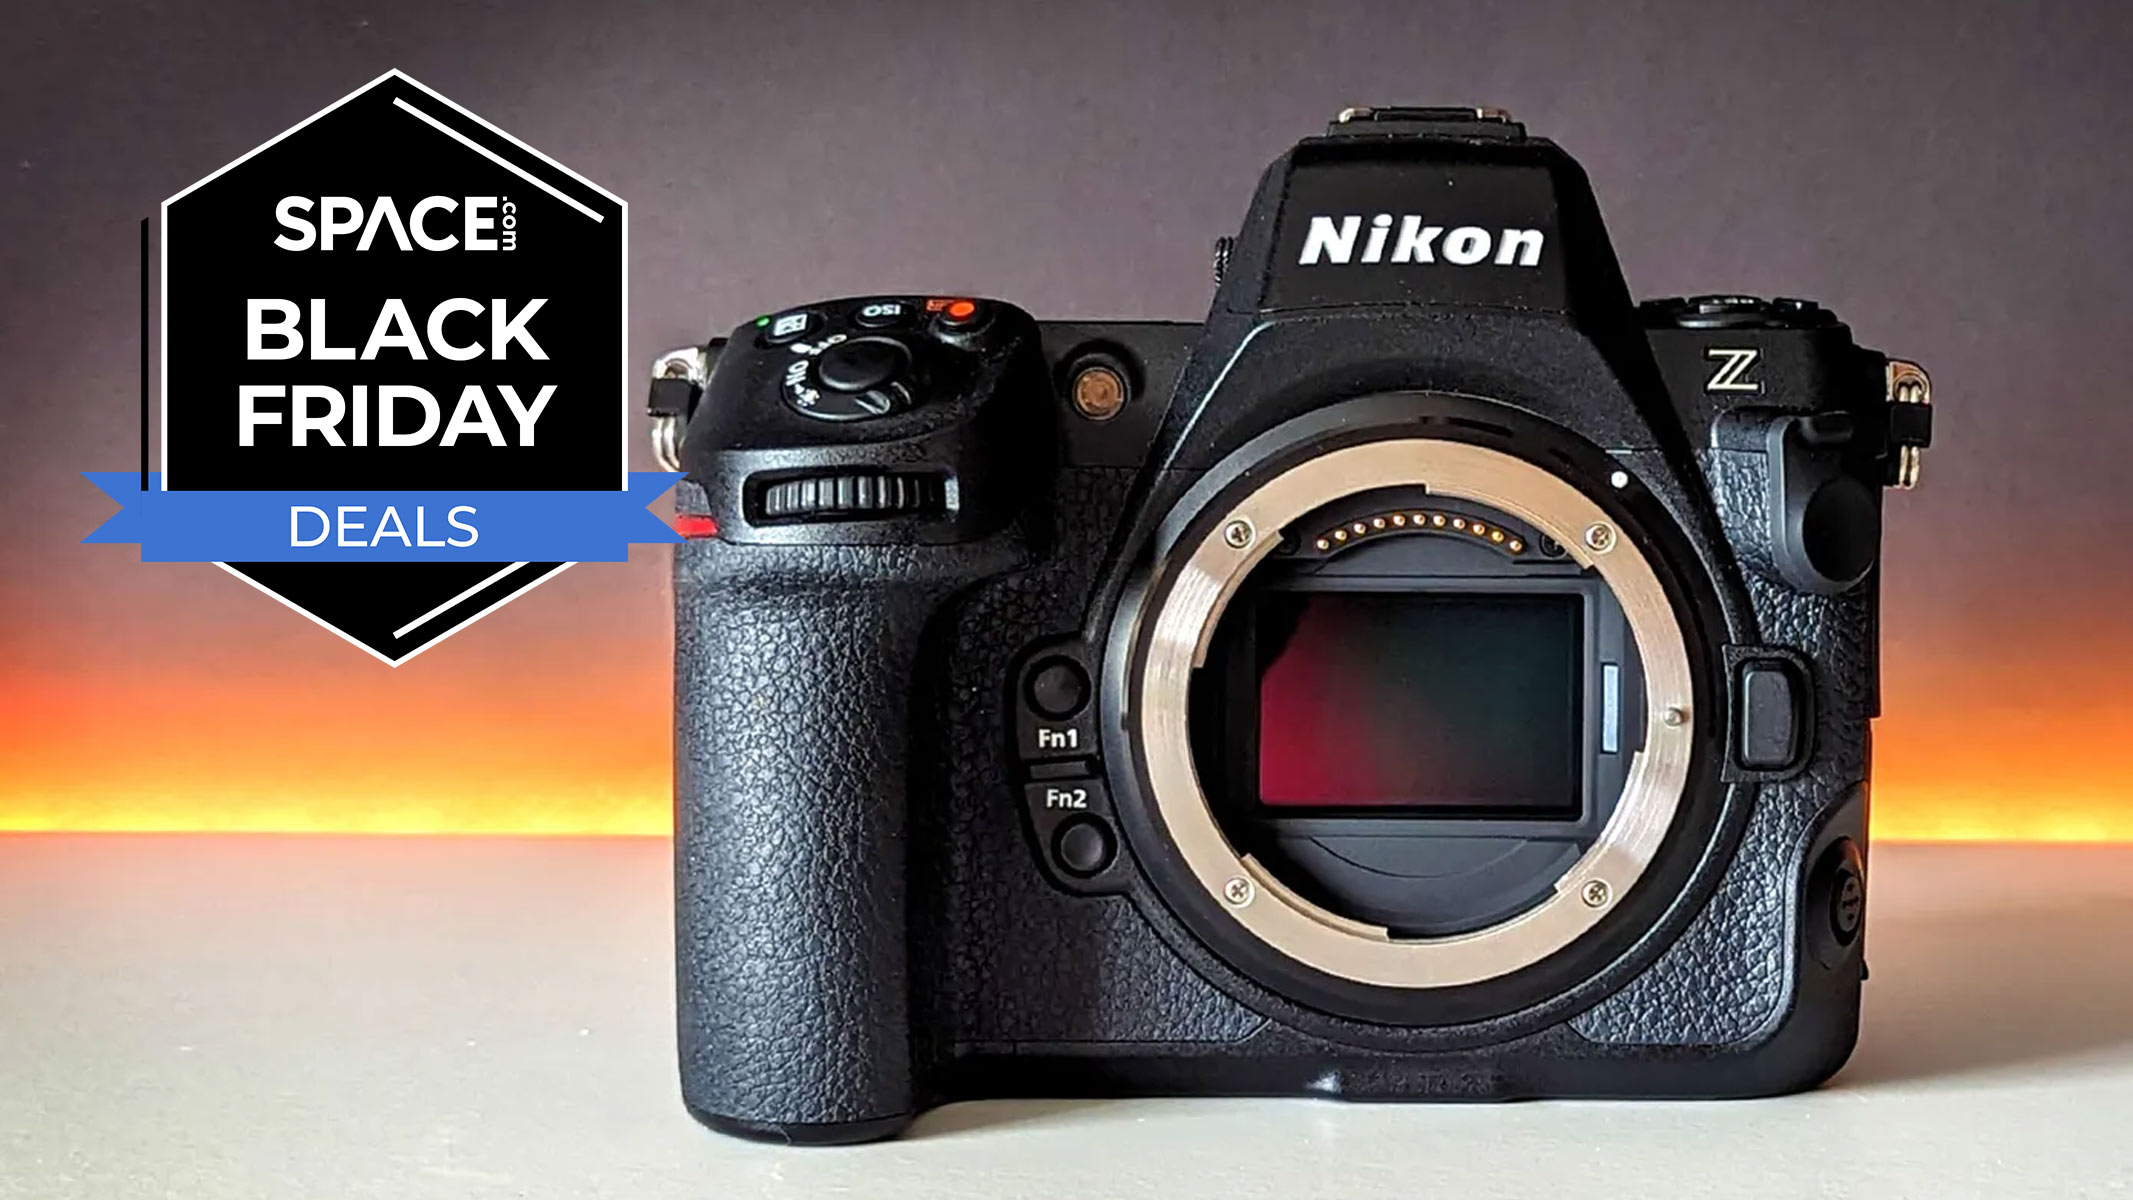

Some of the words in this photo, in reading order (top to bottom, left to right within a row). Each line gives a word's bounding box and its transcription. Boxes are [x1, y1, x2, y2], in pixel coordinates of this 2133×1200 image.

[1298, 213, 1545, 268] Nikon
[862, 303, 902, 317] ISO
[1707, 349, 1759, 391] Z
[1038, 728, 1078, 748] Fn1
[1046, 788, 1087, 809] Fn2
